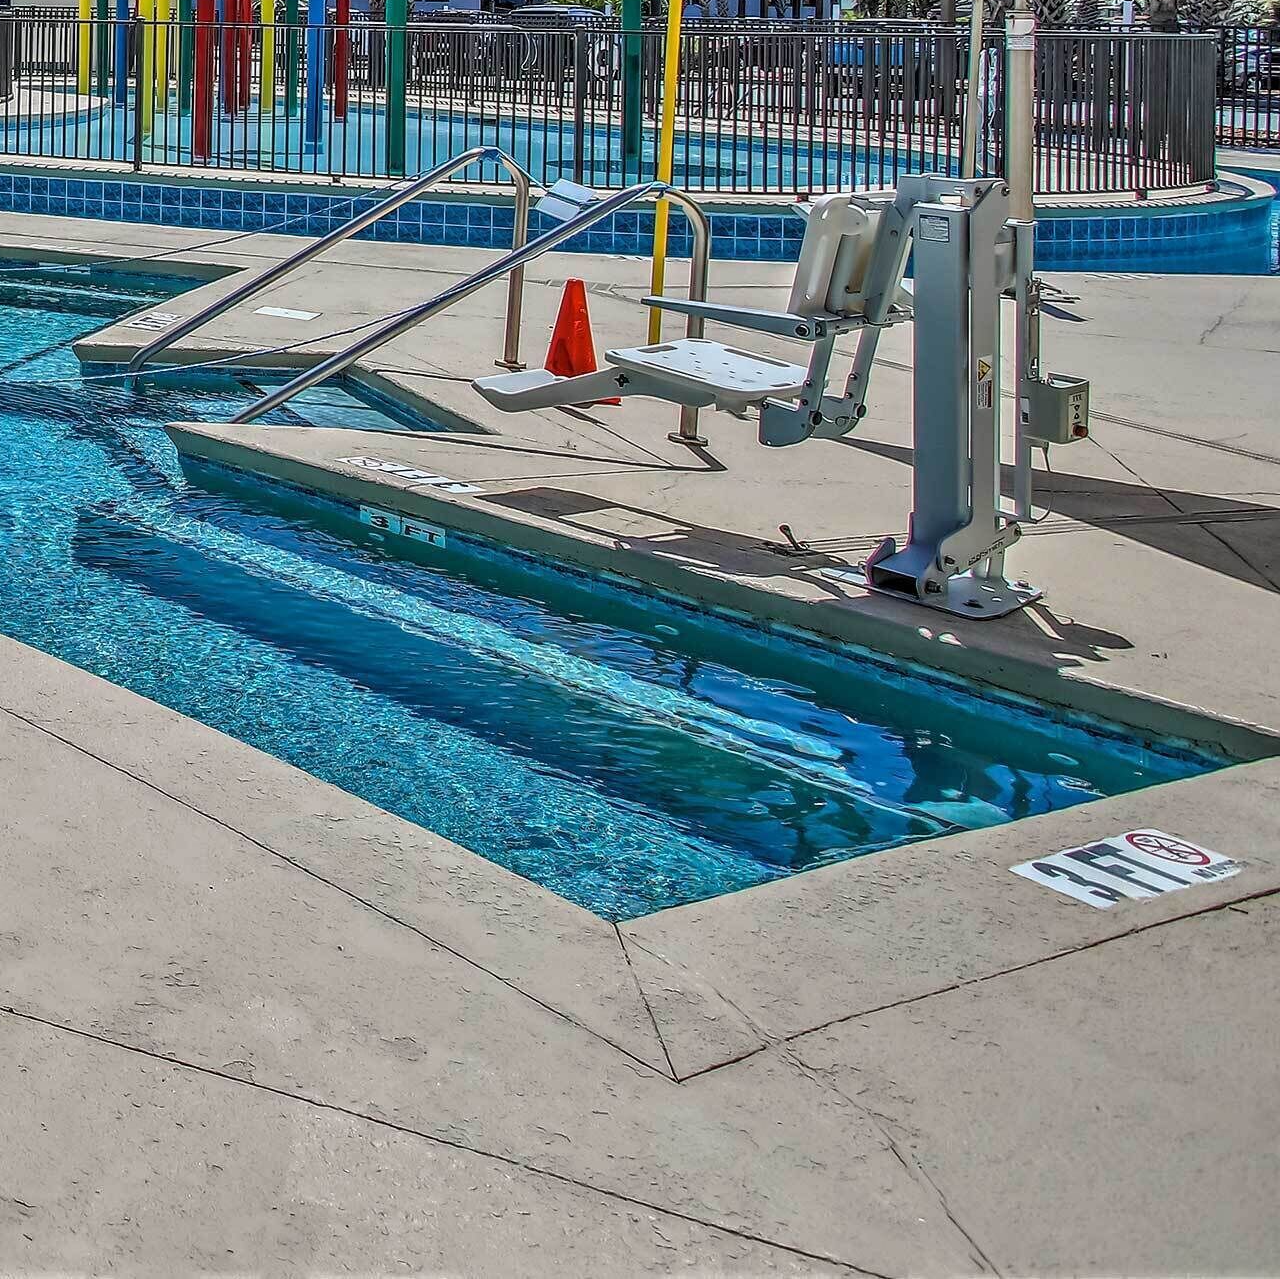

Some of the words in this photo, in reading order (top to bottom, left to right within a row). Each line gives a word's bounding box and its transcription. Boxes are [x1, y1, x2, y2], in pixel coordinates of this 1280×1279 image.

[371, 514, 389, 529] 3
[404, 524, 442, 544] FT
[1031, 861, 1130, 902] 3
[1062, 842, 1193, 894] FT
